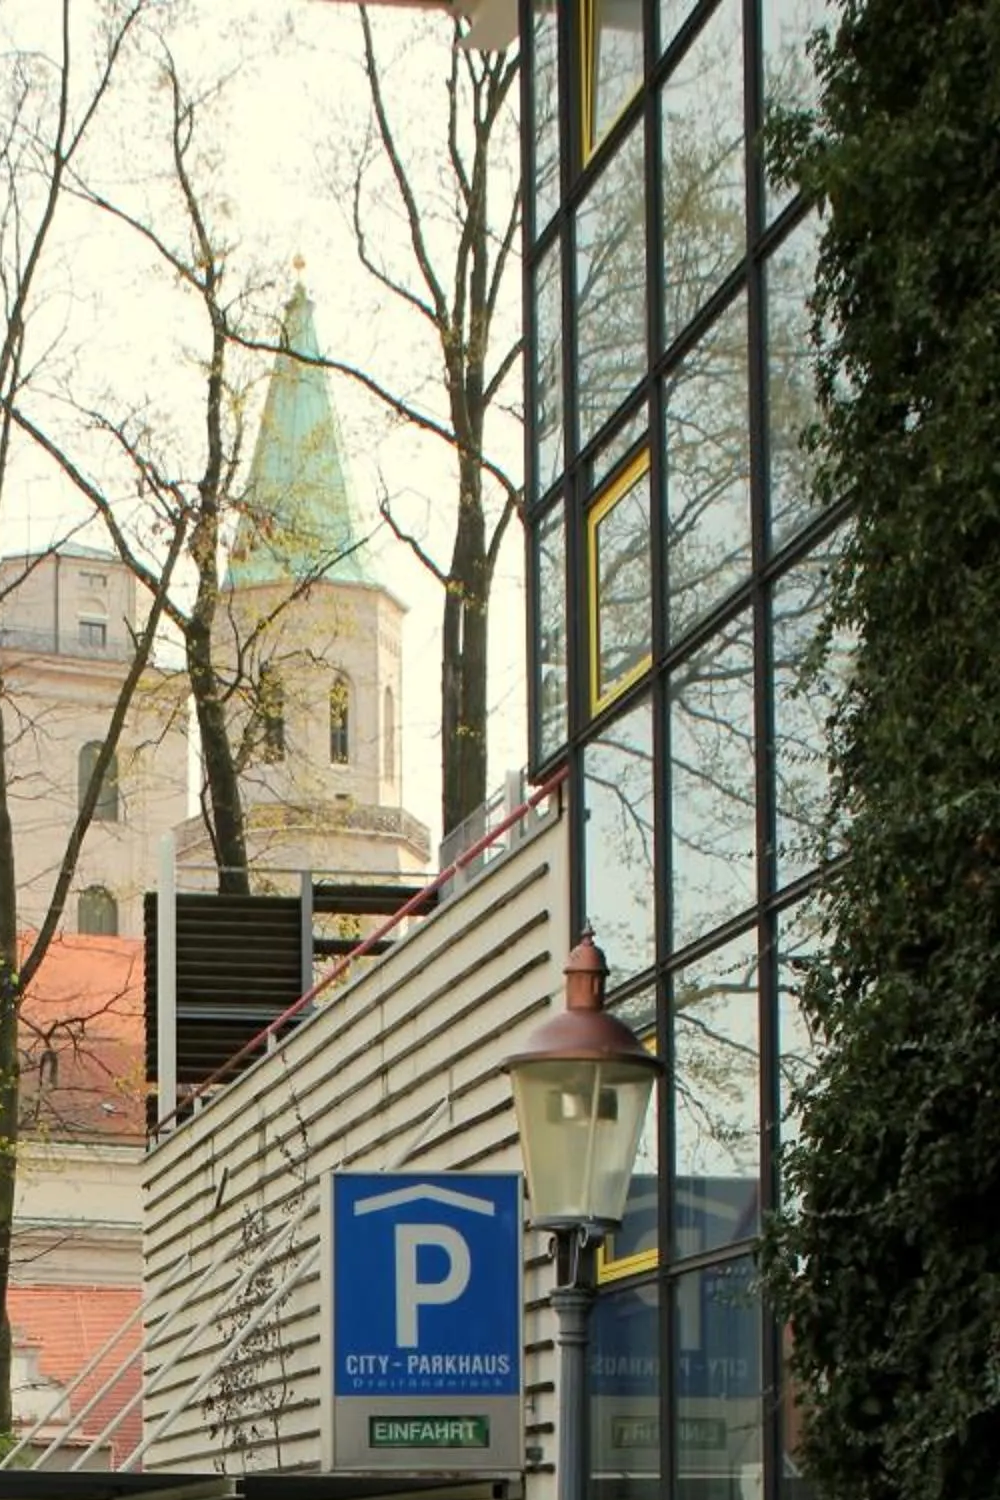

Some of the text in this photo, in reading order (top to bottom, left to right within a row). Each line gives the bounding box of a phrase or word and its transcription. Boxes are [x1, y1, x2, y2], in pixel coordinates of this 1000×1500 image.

[395, 1223, 471, 1348] P
[346, 1355, 389, 1375] CITY
[407, 1355, 510, 1376] PARKHAUS
[374, 1422, 476, 1440] EINFAHRT
